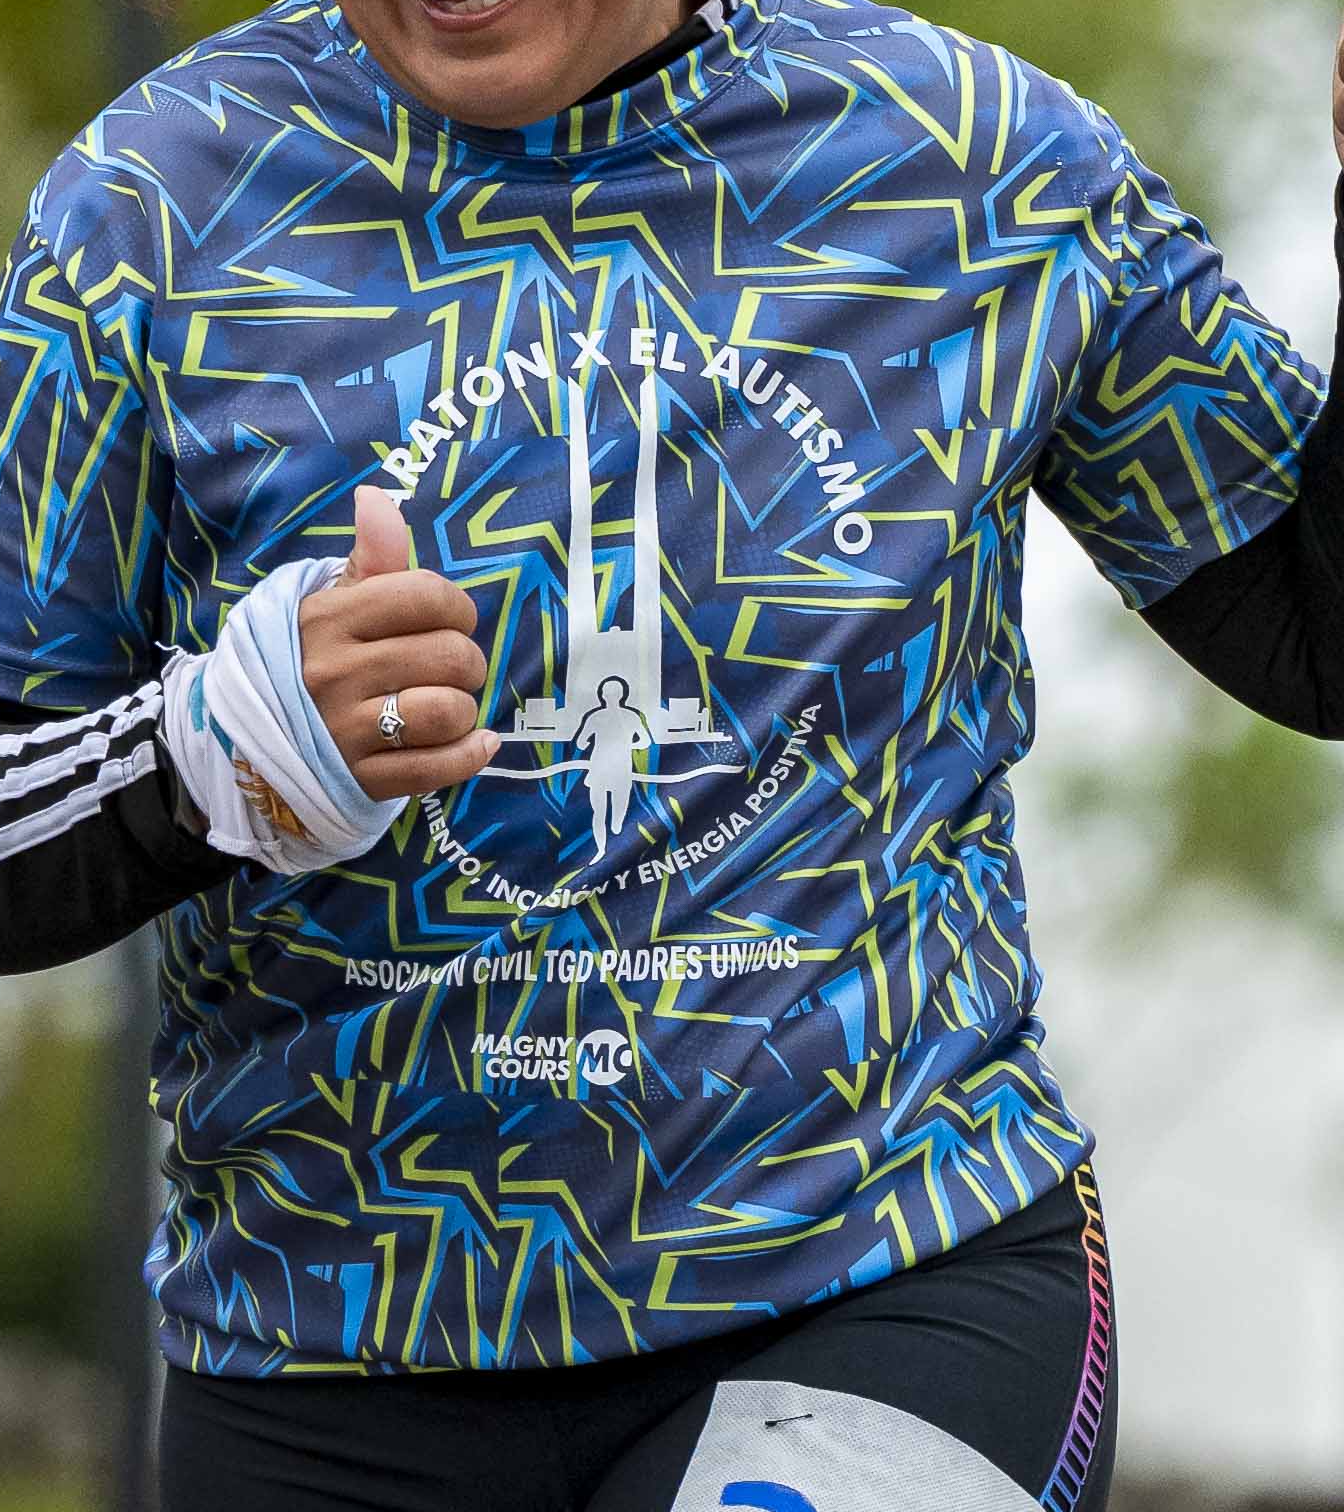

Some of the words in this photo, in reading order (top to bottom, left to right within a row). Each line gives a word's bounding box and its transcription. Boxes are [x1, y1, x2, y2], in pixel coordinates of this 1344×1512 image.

[567, 329, 611, 371] X
[629, 327, 687, 372] EL
[700, 345, 873, 555] AUTISMO
[614, 869, 631, 890] Y
[638, 811, 753, 884] ENERGÍA
[744, 703, 822, 815] POSITIVA
[473, 949, 538, 984] CIVIL
[543, 948, 595, 984] TGD
[599, 944, 704, 983] PADRES
[709, 934, 800, 980] UNIDOS
[471, 1033, 575, 1057] MAGNY
[485, 1057, 571, 1081] COURS
